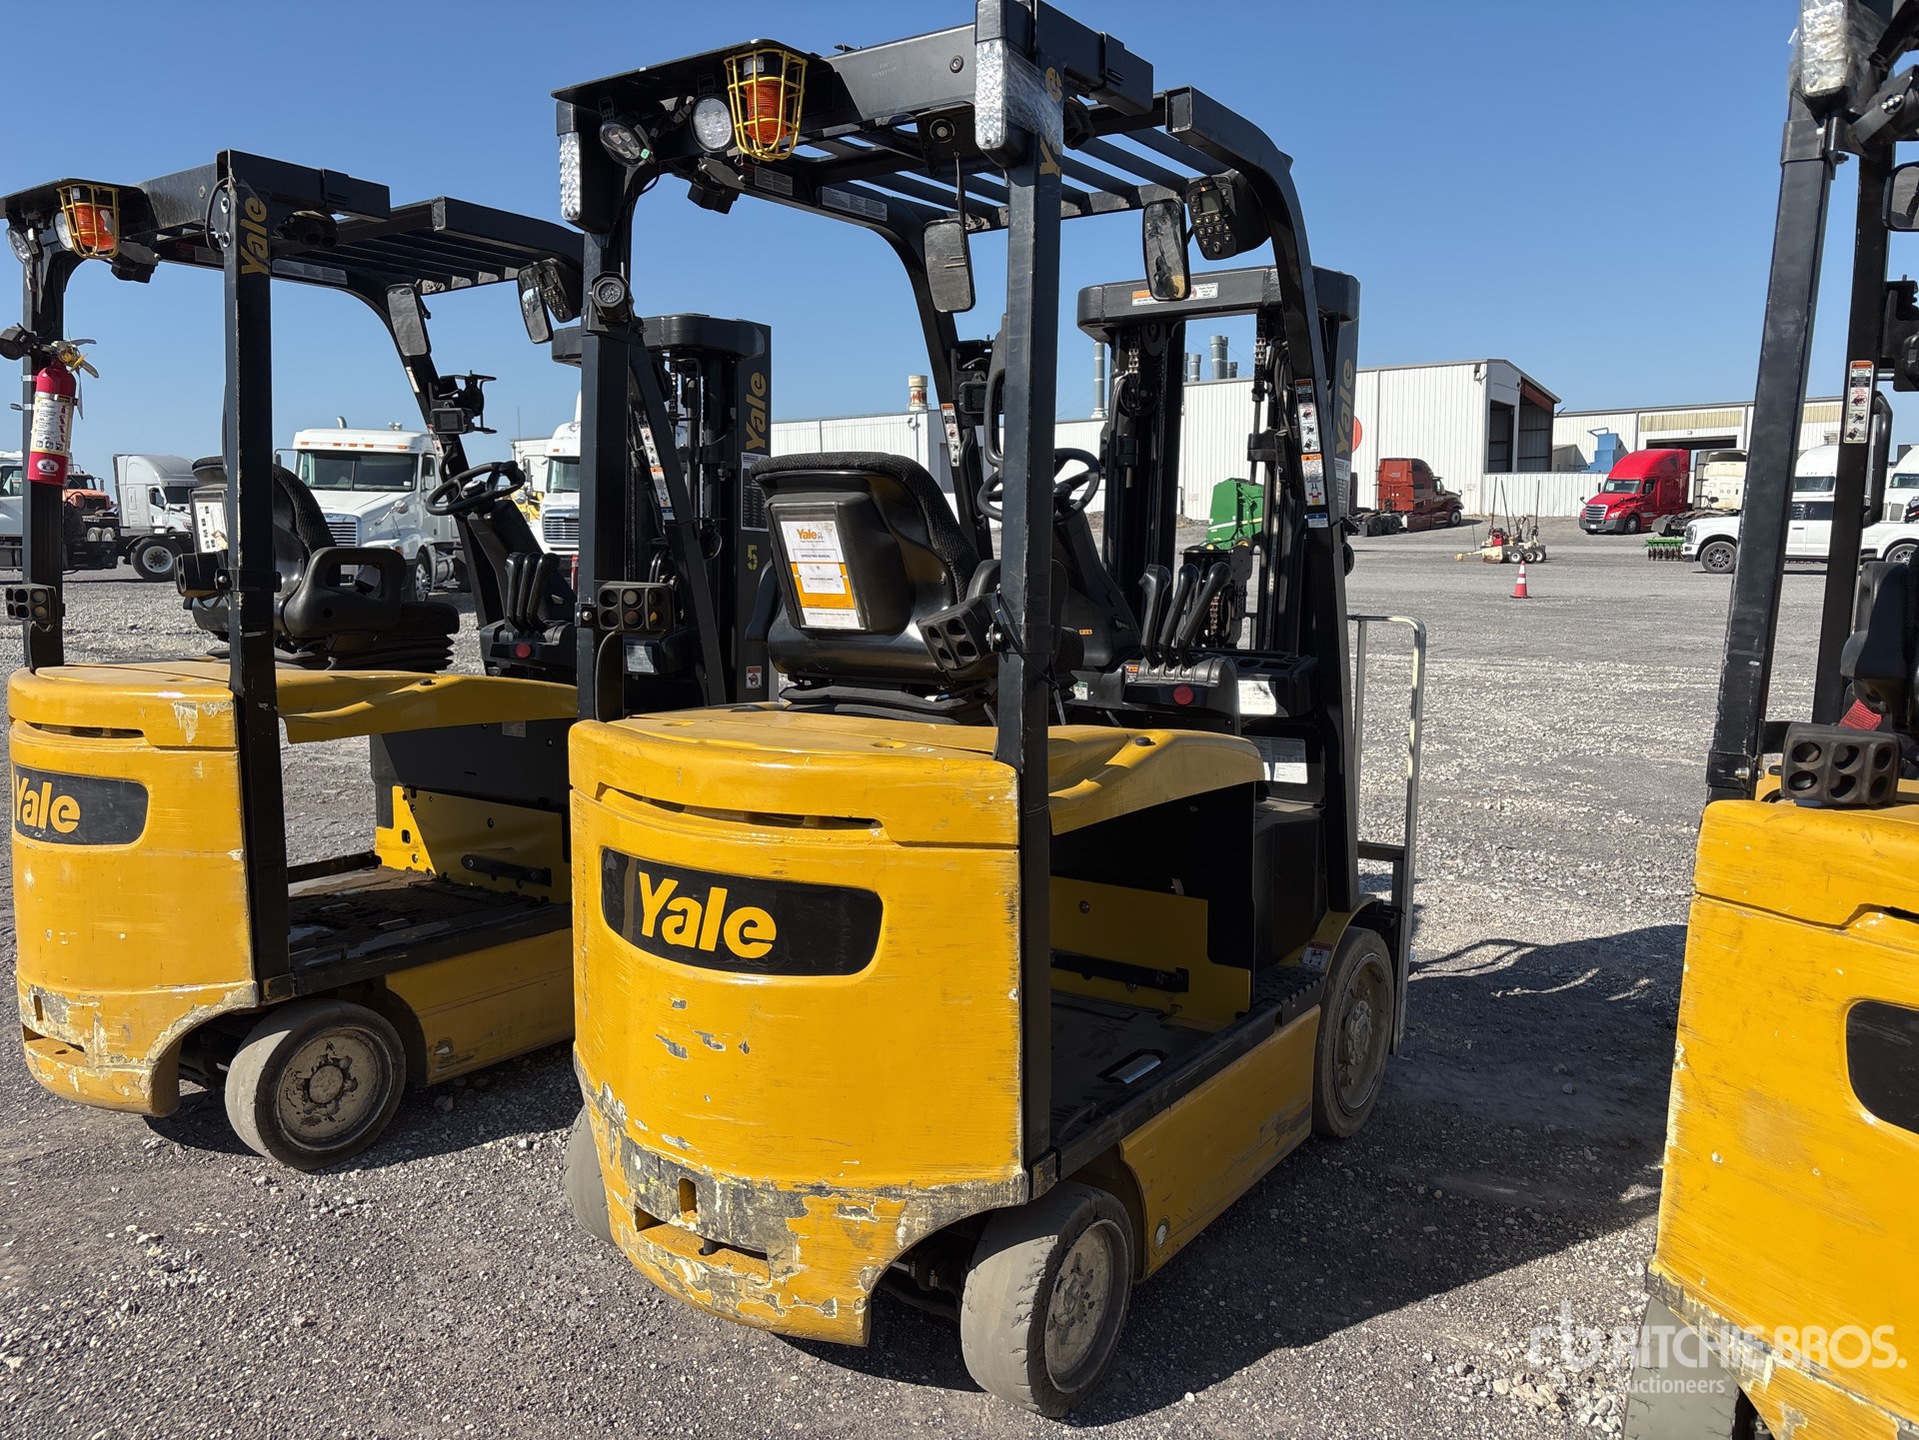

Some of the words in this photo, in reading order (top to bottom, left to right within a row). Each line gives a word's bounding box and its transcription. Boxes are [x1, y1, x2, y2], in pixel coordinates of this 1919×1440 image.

[1039, 66, 1062, 177] Ye
[240, 197, 269, 275] Yale
[746, 372, 767, 450] Yale
[1336, 359, 1353, 454] Yale
[747, 544, 758, 571] 5
[796, 529, 817, 540] Yale
[15, 774, 80, 834] Yale
[638, 871, 777, 959] Yale
